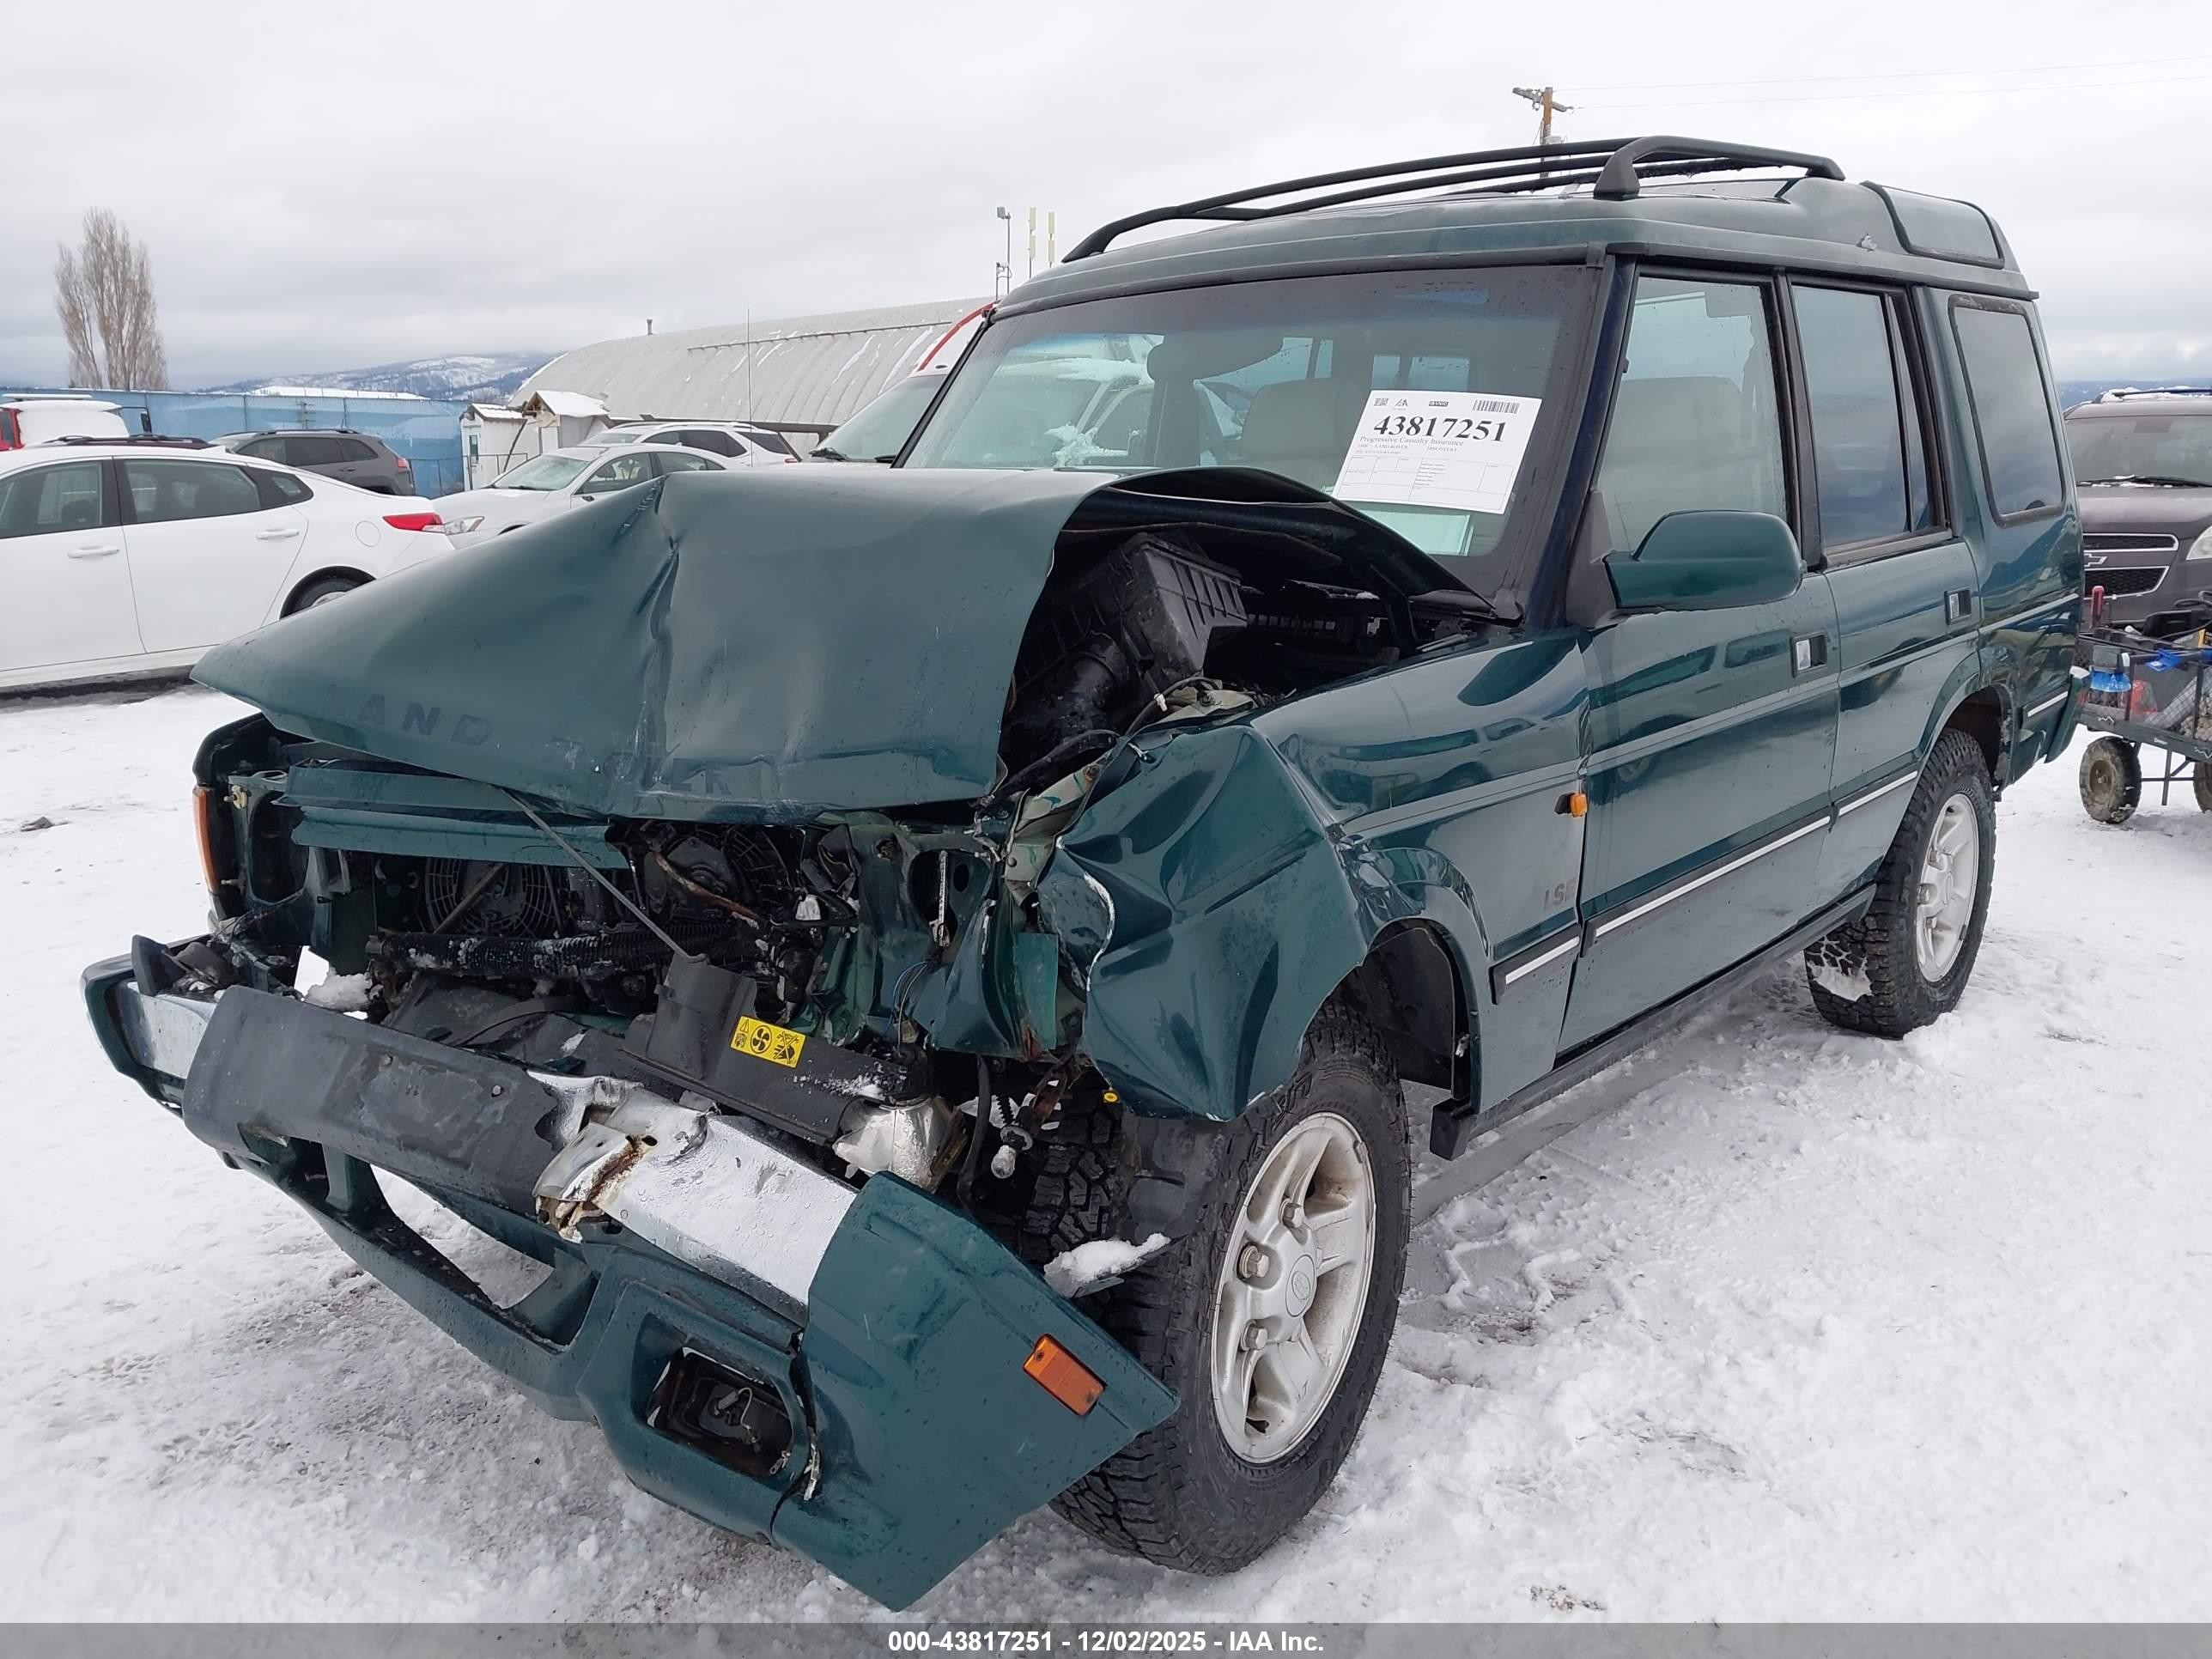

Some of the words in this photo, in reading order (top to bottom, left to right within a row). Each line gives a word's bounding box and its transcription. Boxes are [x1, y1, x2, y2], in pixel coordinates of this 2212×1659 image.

[1374, 416, 1505, 442] 43817251
[1400, 436, 1429, 445] Casualty
[1430, 438, 1464, 447] Insurance
